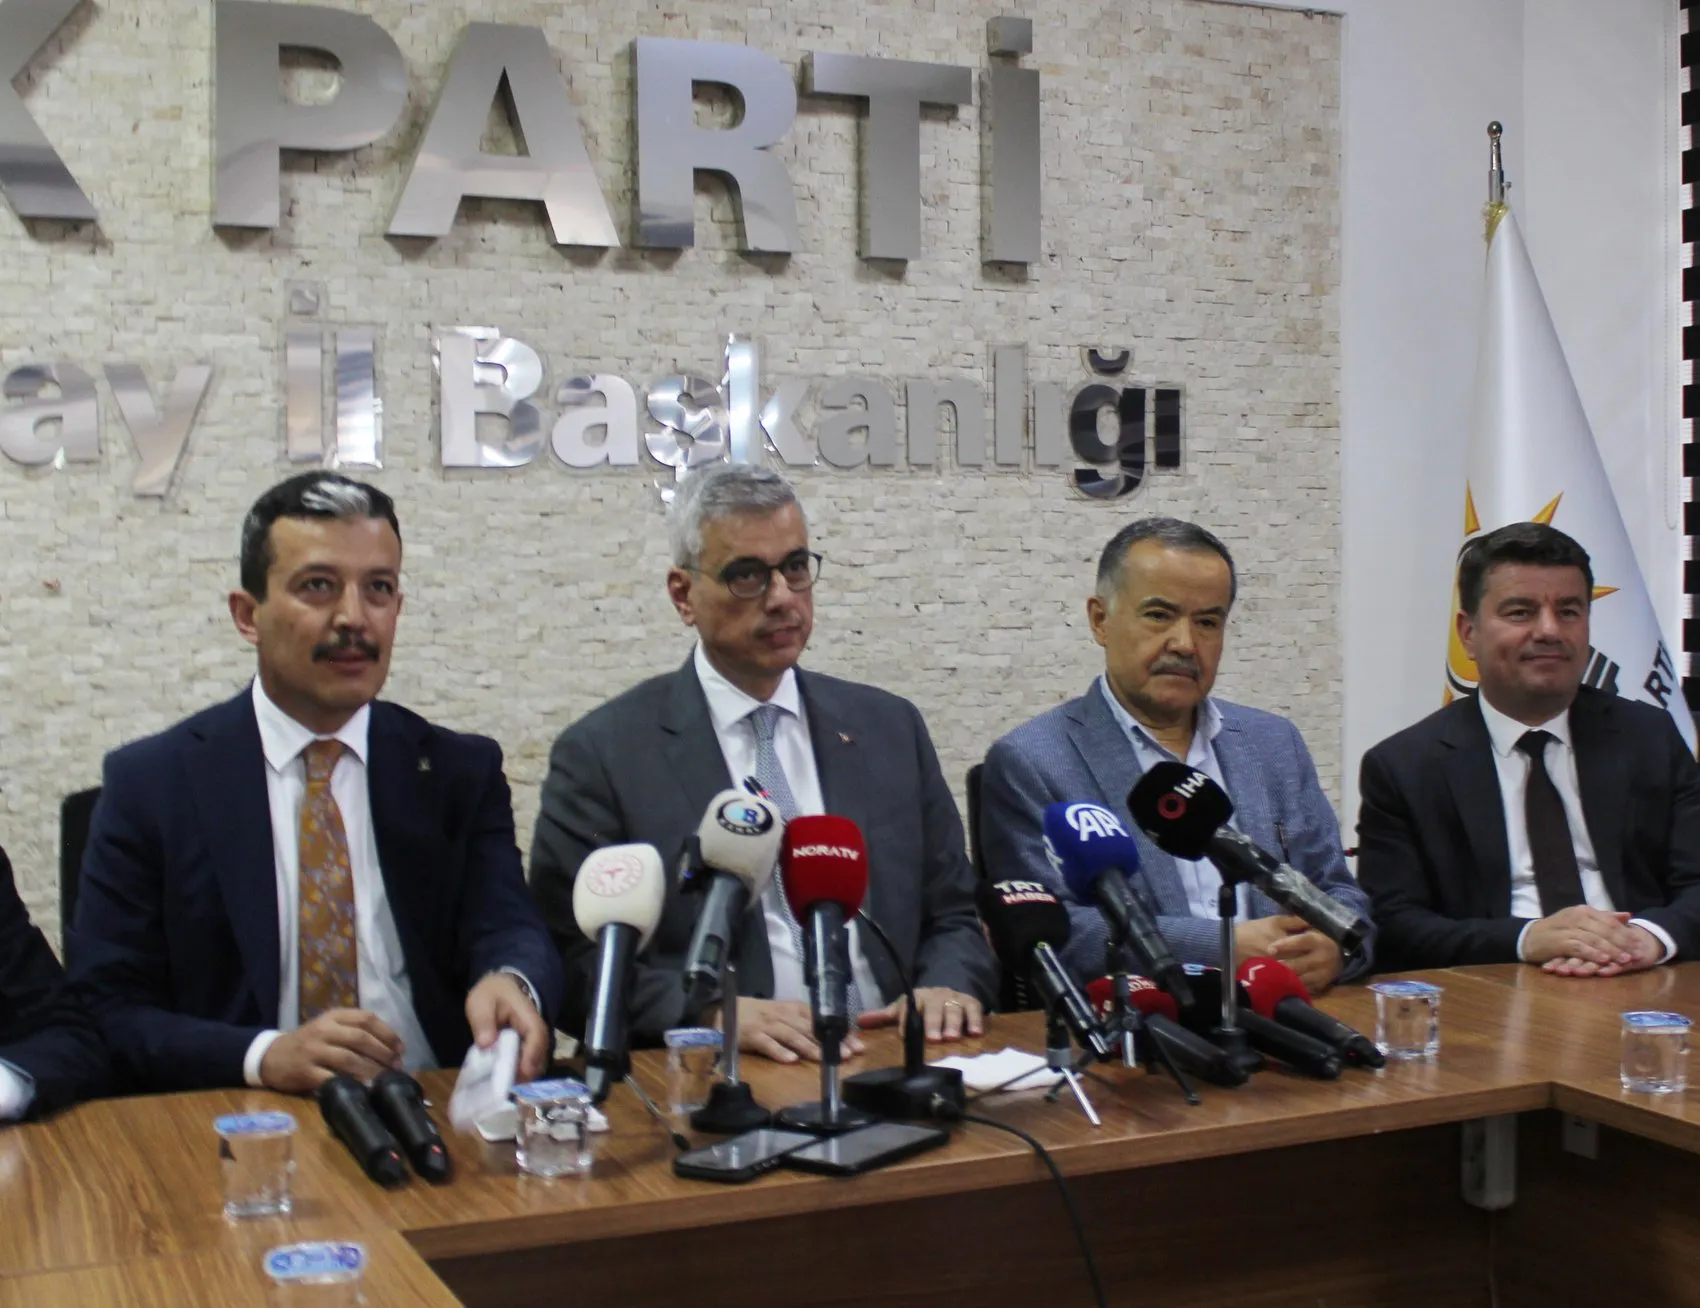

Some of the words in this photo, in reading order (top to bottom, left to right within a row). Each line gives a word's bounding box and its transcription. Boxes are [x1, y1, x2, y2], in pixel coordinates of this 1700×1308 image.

[212, 0, 1040, 265] PARTİ
[434, 325, 1181, 499] Başkanlığı
[993, 880, 1045, 893] TRT
